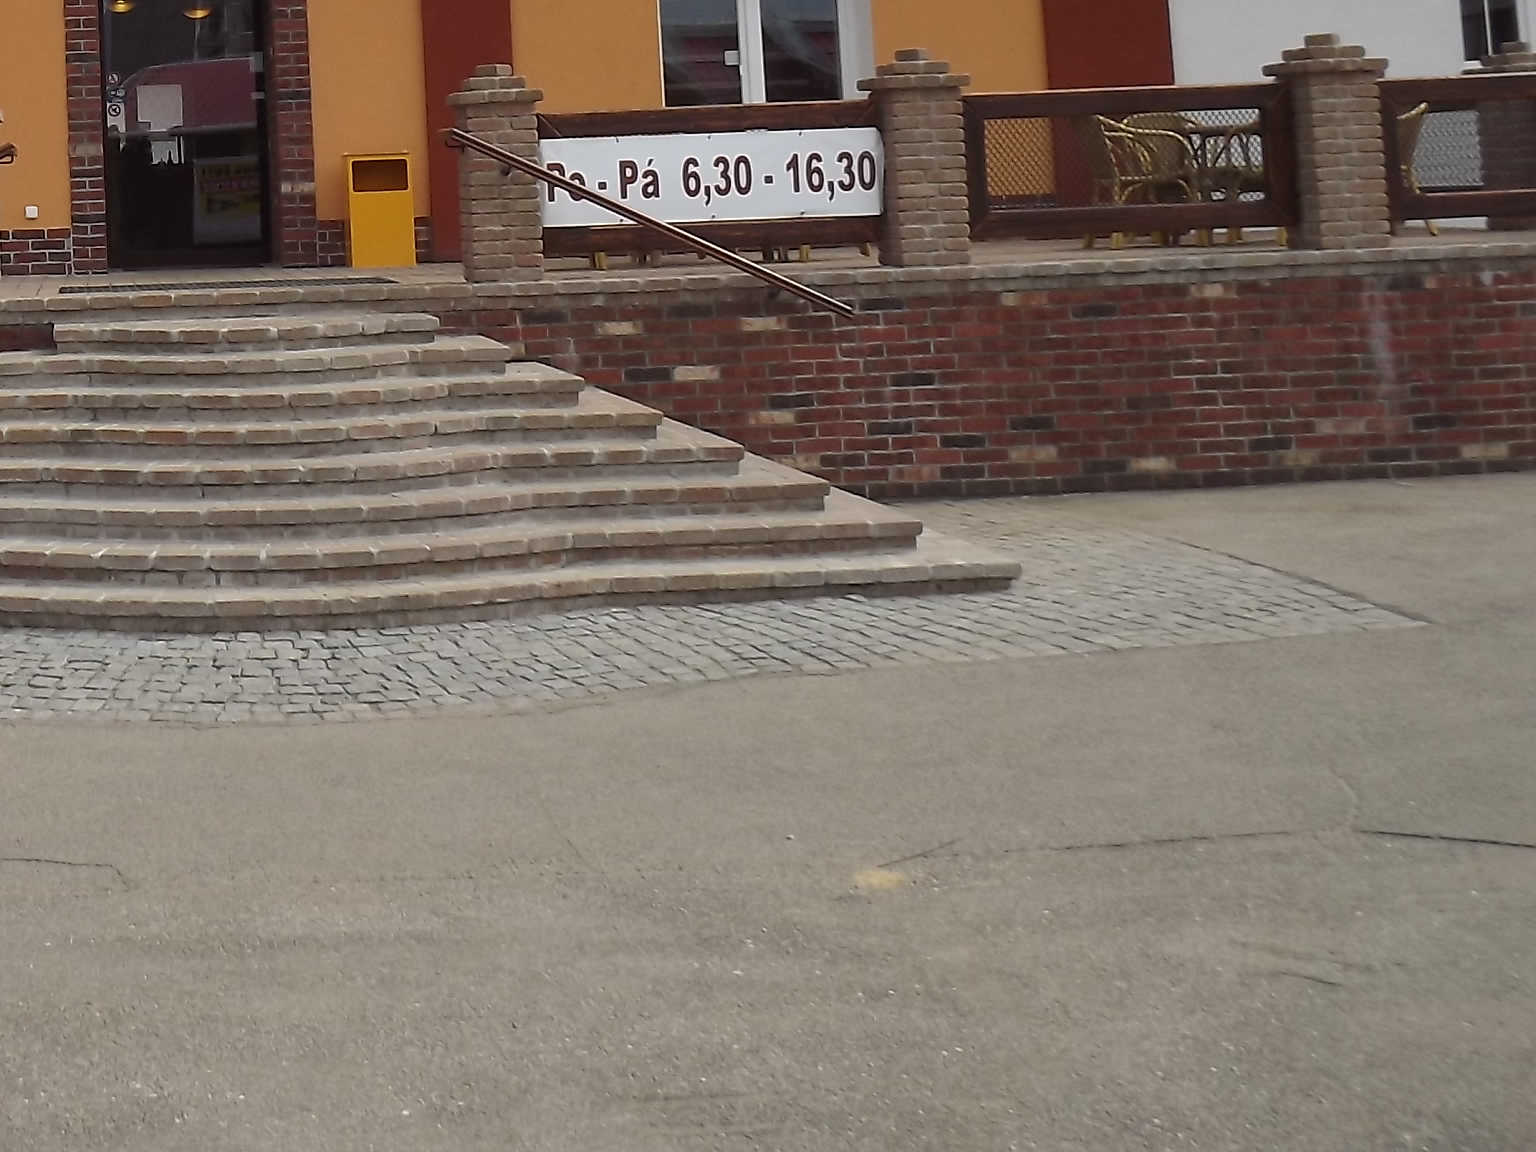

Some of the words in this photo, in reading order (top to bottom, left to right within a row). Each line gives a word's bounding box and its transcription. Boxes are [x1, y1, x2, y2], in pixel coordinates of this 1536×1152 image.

[619, 158, 661, 200] Pá
[682, 155, 753, 206] 6,30
[785, 151, 876, 201] 16,30
